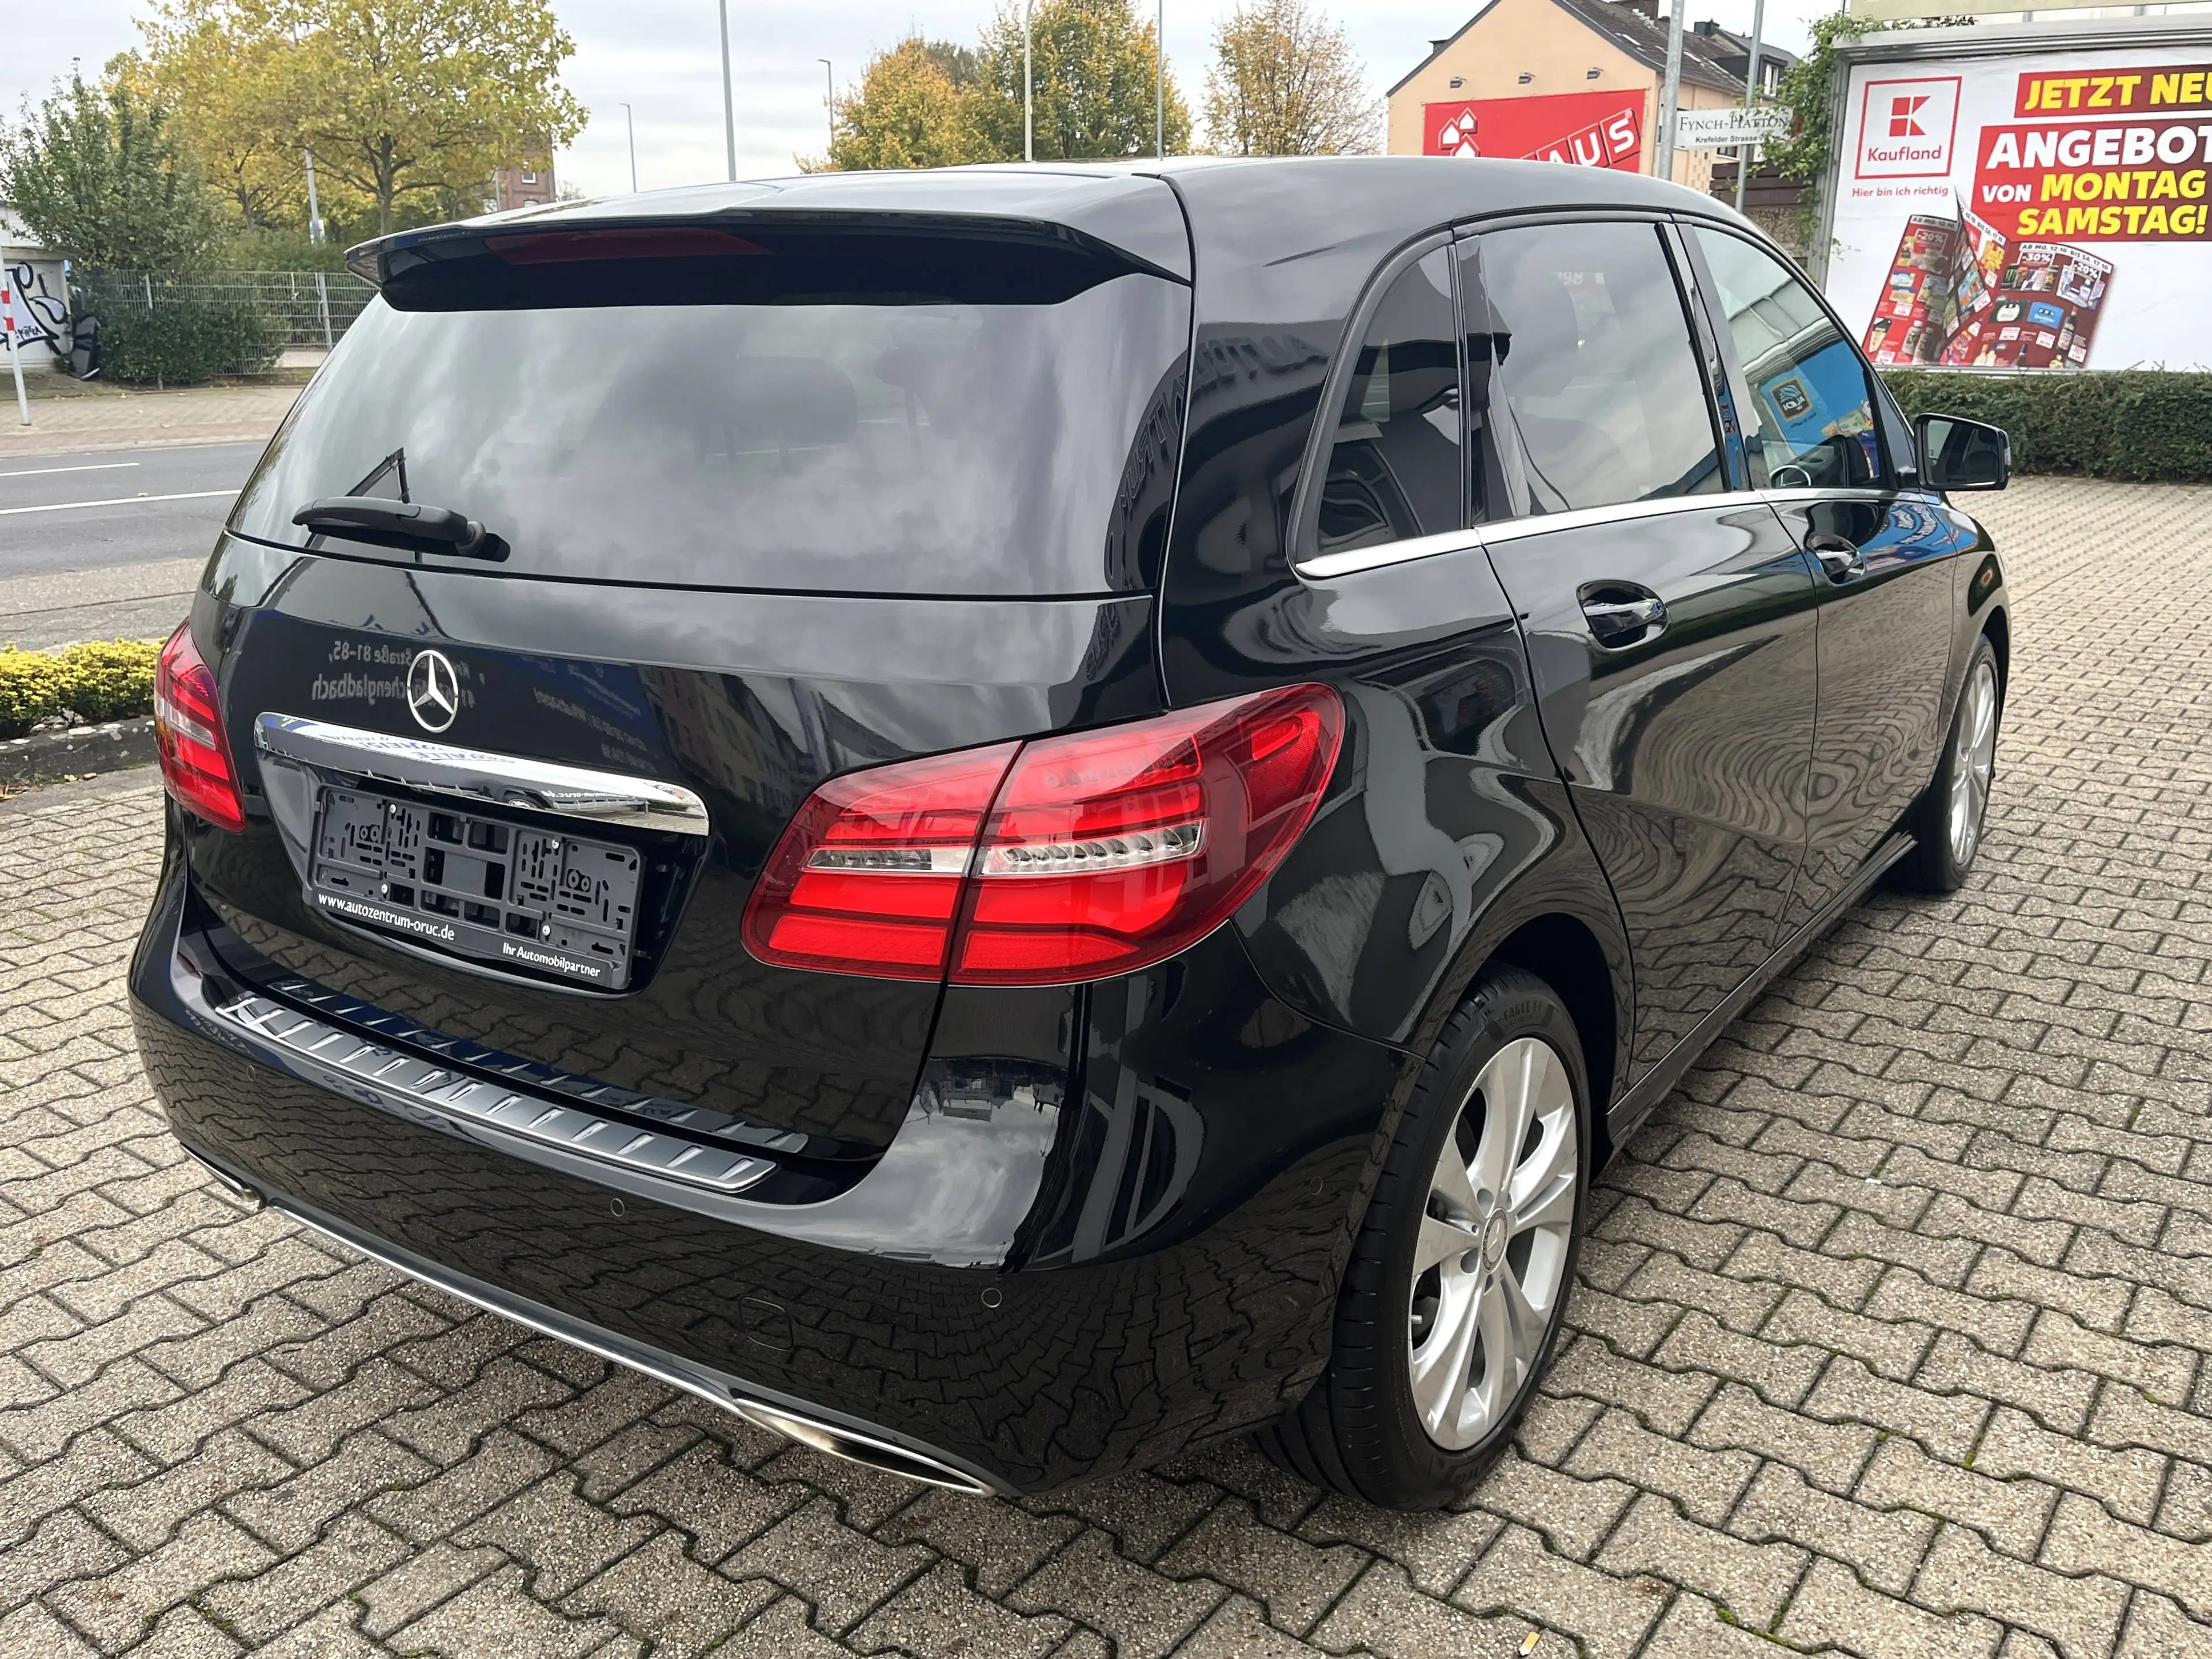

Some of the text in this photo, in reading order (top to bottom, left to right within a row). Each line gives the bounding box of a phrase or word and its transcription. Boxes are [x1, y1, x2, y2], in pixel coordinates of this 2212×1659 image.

[2024, 75, 2142, 110] JETZT
[1680, 115, 1788, 131] FYNCH-HATTON
[1867, 145, 1942, 162] Kaufland
[1852, 185, 1949, 197] Hier bin ich richtig
[1982, 169, 2207, 203] VON MONTAG
[2016, 204, 2209, 236] SAMSTAG!
[2022, 253, 2051, 262] -30%
[2070, 250, 2081, 258] BIS
[2074, 263, 2098, 279] -20%
[318, 893, 455, 941] www.autozentrum-oruc.de
[502, 942, 601, 977] Ihr Automobilpartner
